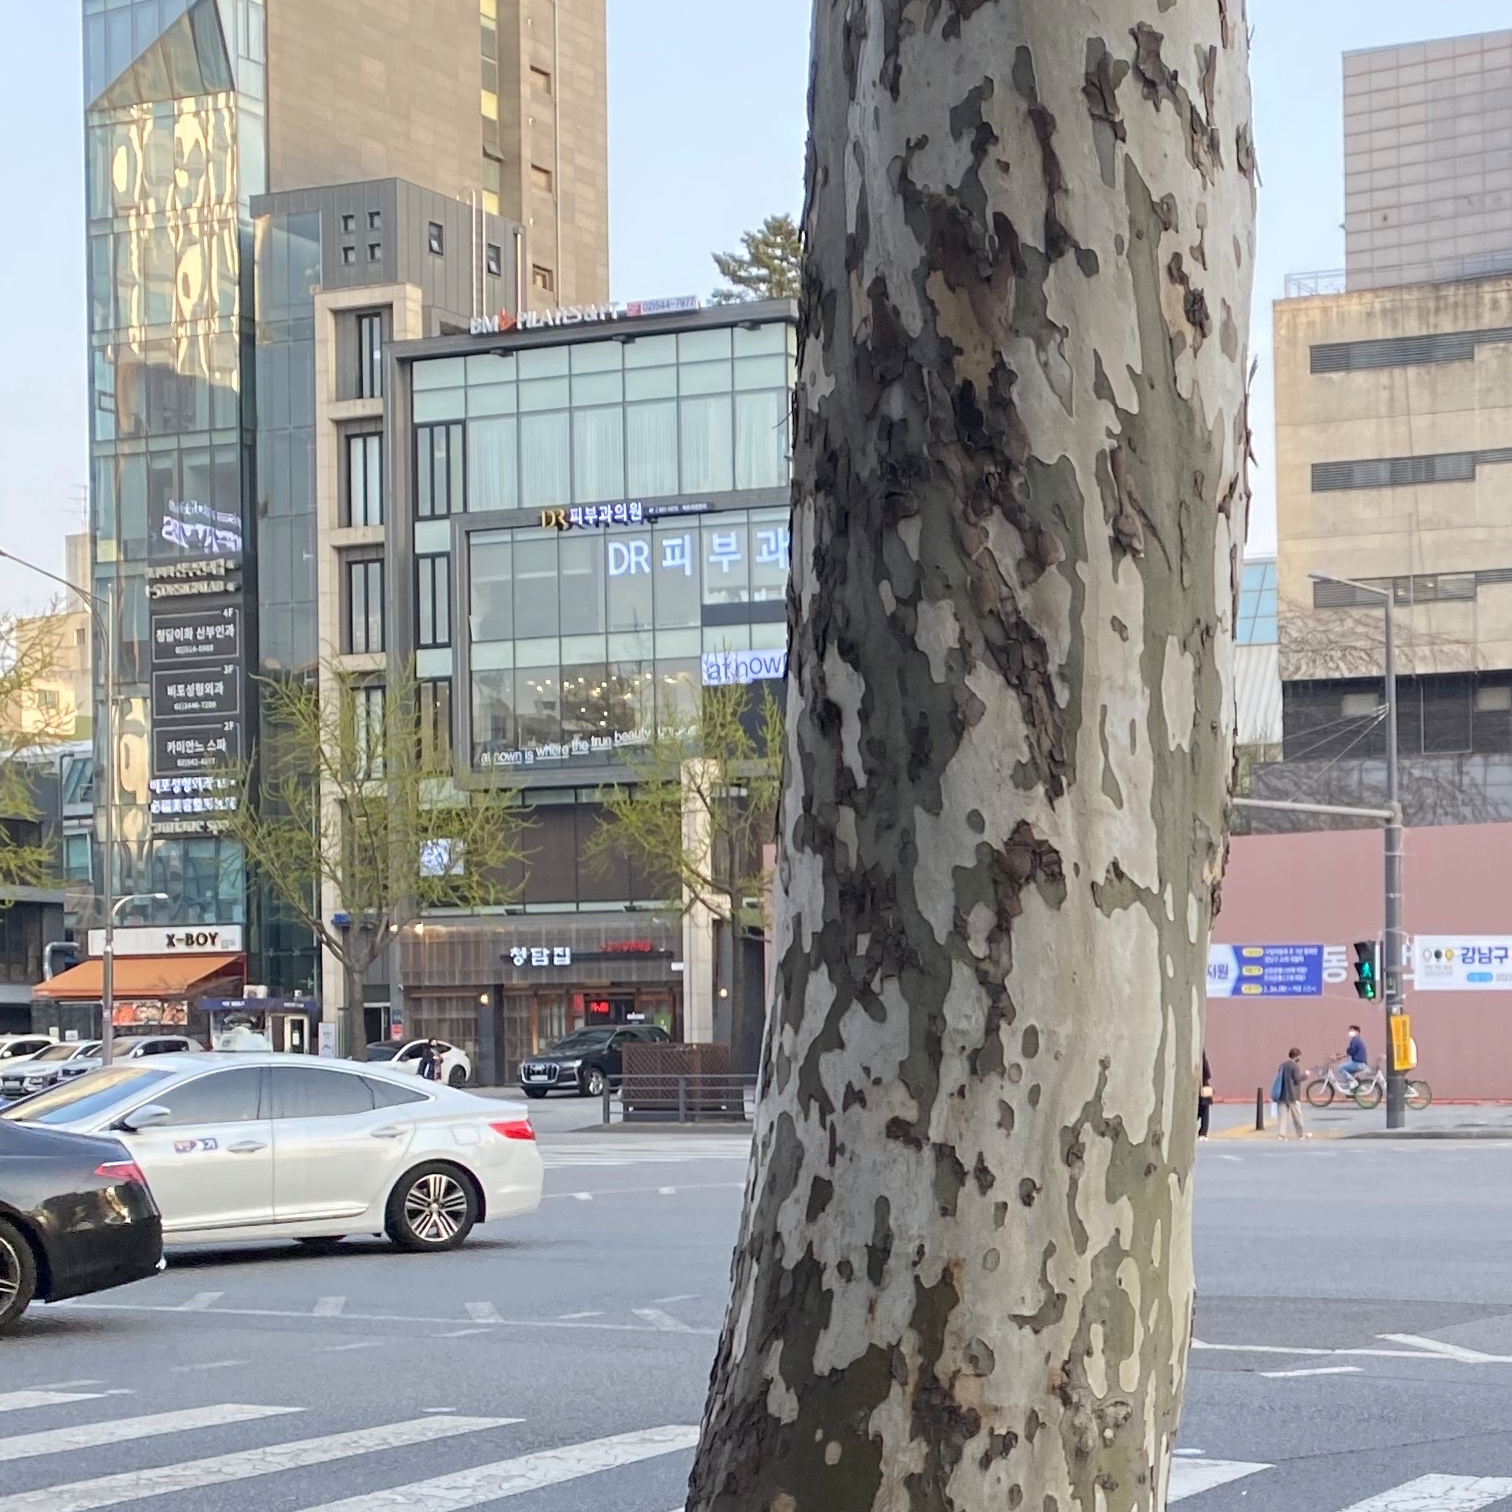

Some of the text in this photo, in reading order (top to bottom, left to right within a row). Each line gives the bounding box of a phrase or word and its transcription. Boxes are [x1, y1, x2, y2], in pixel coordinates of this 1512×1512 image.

[570, 502, 642, 525] 피부과의원
[608, 539, 651, 576] DR
[223, 608, 234, 617] 4F
[223, 665, 234, 674] 3F
[166, 932, 219, 948] X-BOY
[510, 946, 572, 967] 청담집
[1461, 946, 1509, 965] 강남구
